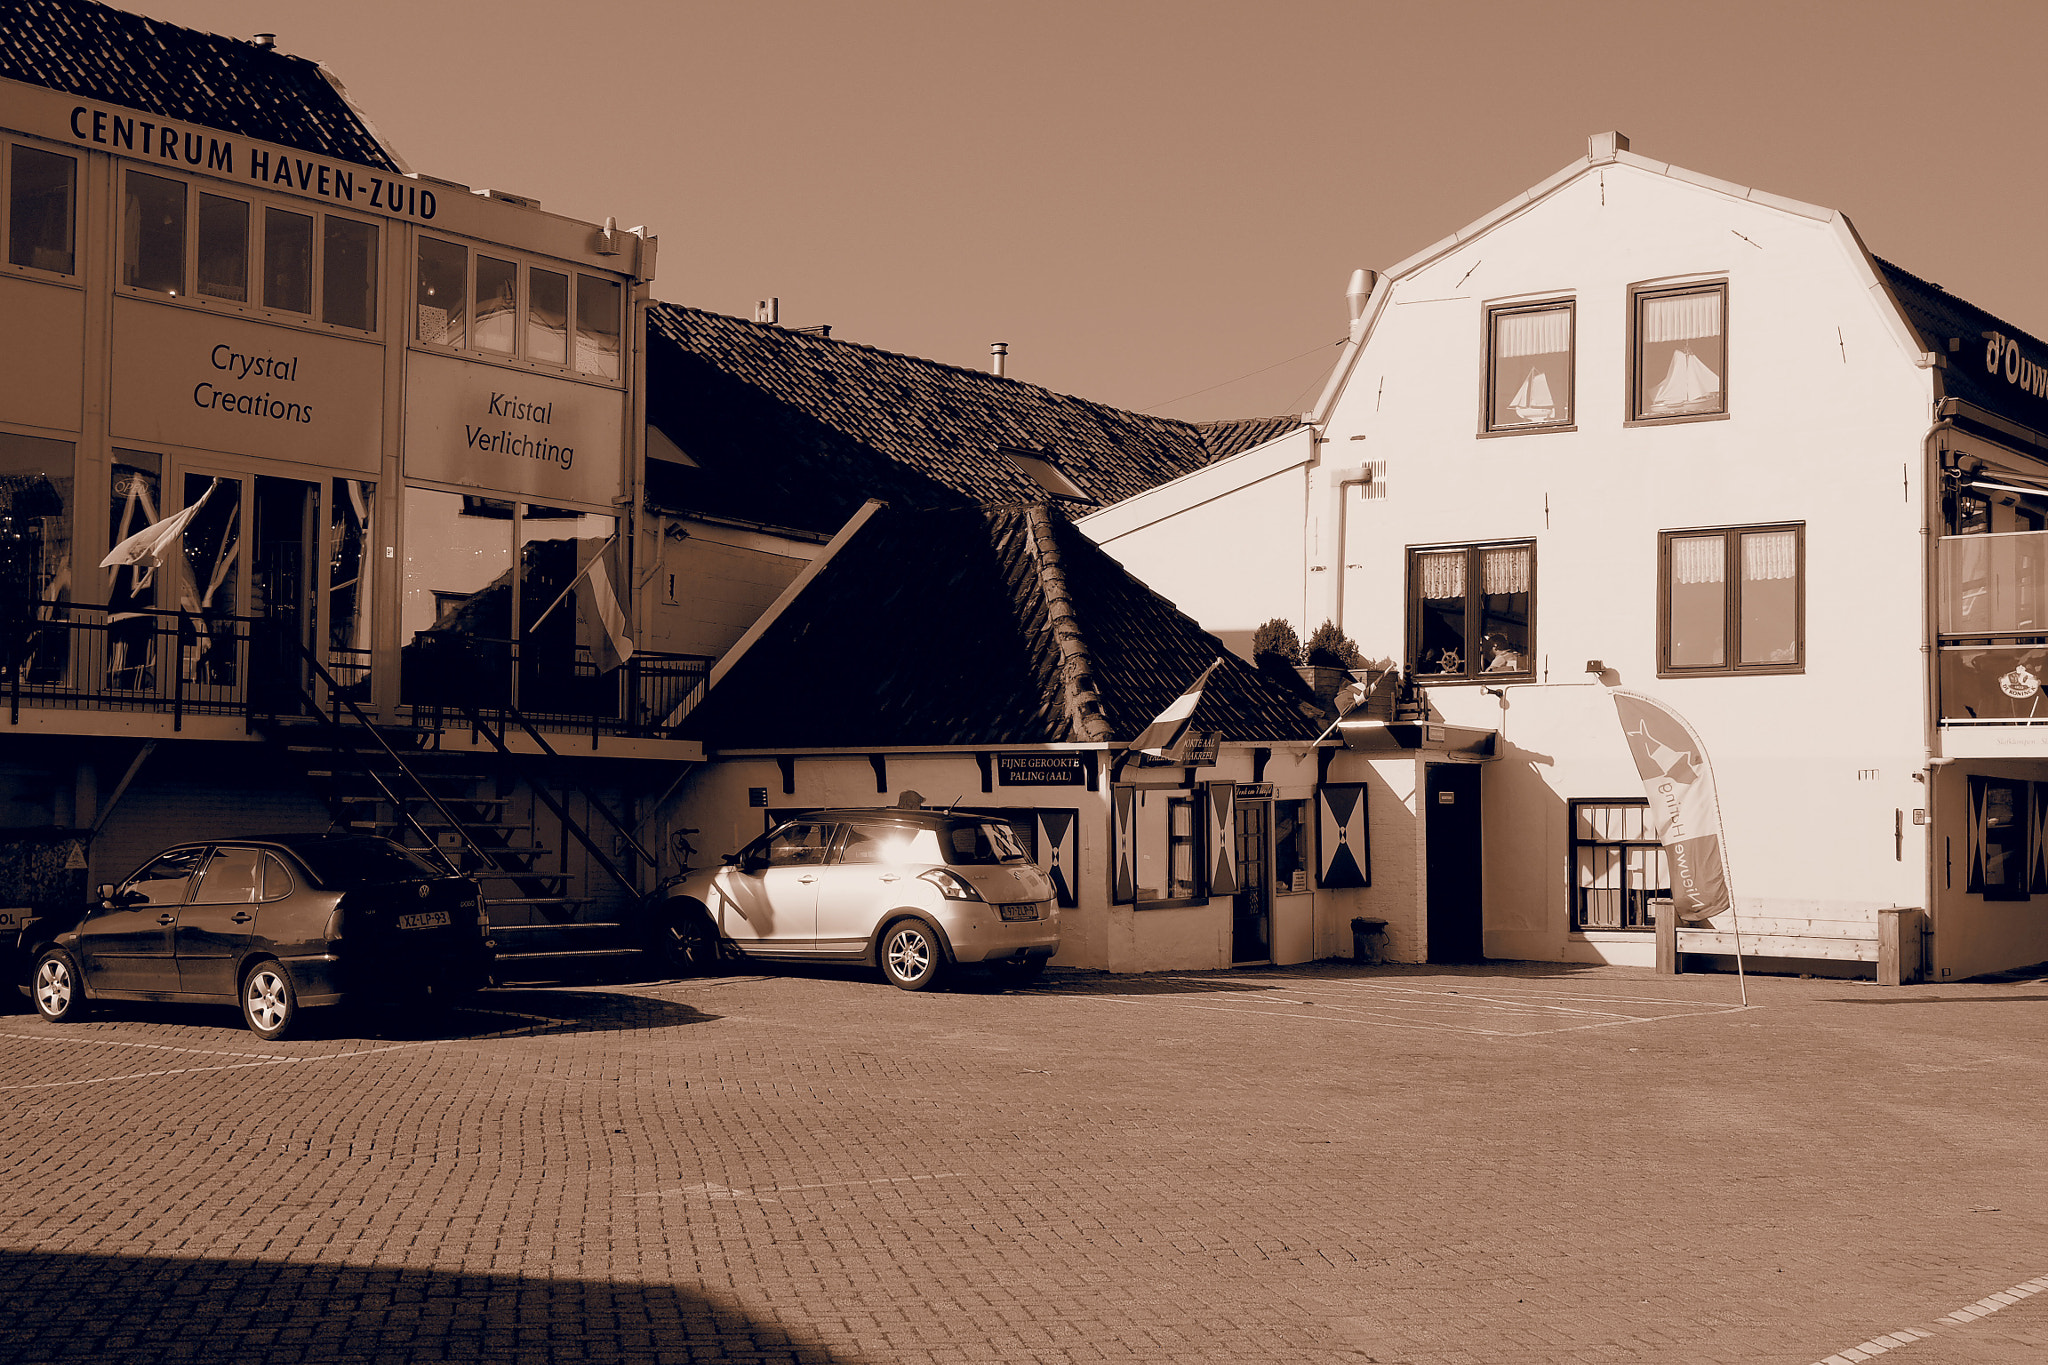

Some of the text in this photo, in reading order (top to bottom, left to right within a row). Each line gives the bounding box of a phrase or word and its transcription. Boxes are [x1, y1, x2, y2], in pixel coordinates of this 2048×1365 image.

[70, 106, 437, 220] CENTRUM HAVEN-ZUID
[211, 344, 298, 381] Crystal
[1986, 330, 2048, 401] d'Ouw
[193, 382, 313, 424] Creations
[488, 391, 553, 425] Kristal
[465, 424, 574, 471] Verlichting
[1001, 758, 1080, 769] FIJNE GEROOKTE
[1010, 771, 1072, 782] PALING (AAL)
[403, 912, 447, 928] XZ-LP-93
